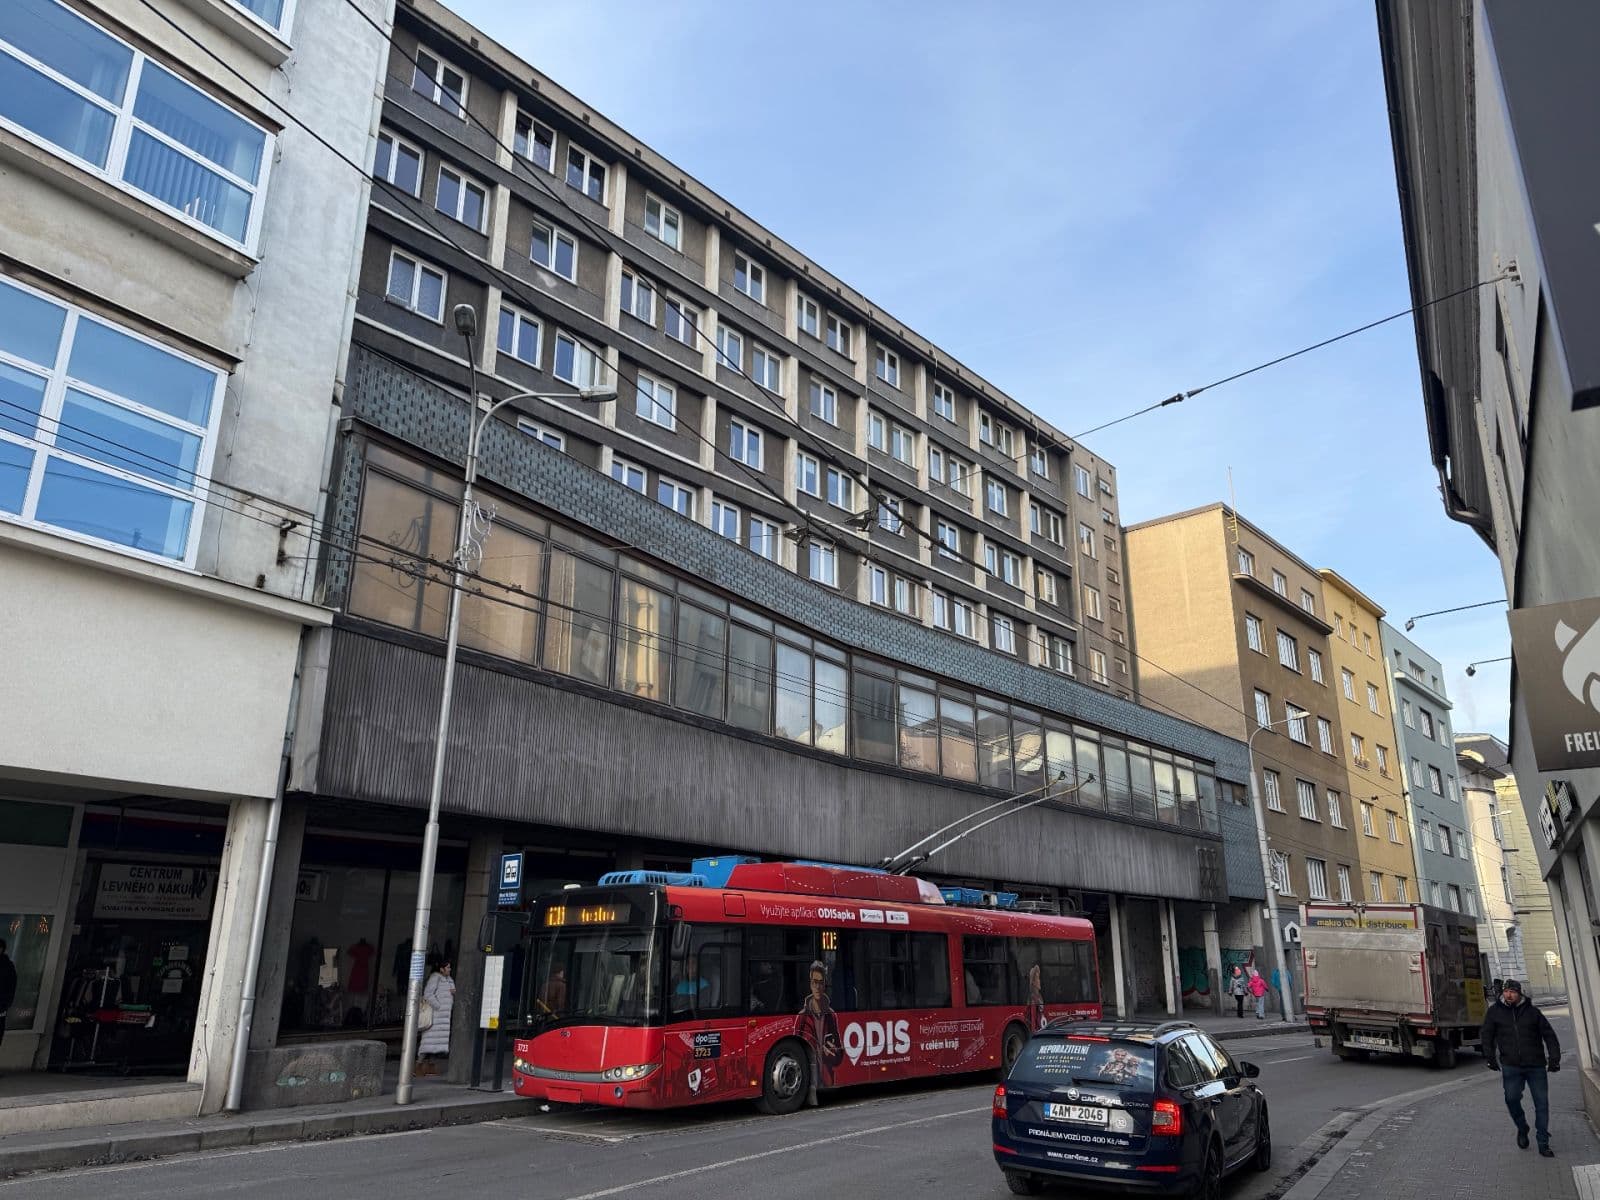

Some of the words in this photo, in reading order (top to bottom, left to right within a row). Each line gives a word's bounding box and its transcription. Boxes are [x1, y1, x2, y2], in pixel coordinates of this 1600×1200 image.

[1563, 730, 1600, 753] FREI
[129, 866, 183, 880] CENTRUM
[102, 879, 155, 893] LEVNÉHO
[760, 904, 790, 918] Využijte
[817, 907, 857, 922] ODISapka
[1366, 920, 1408, 928] distribuce
[695, 1033, 708, 1045] dpo
[843, 1019, 911, 1066] ODIS
[925, 1040, 945, 1050] celém
[945, 1037, 960, 1050] kraji
[517, 1043, 529, 1052] 3723
[694, 1047, 712, 1058] 3723
[1051, 1104, 1072, 1118] 4AM
[1078, 1107, 1104, 1121] 2046
[1028, 1128, 1063, 1140] PRONÁJEM
[1081, 1134, 1091, 1143] OD
[1091, 1135, 1106, 1144] 400
